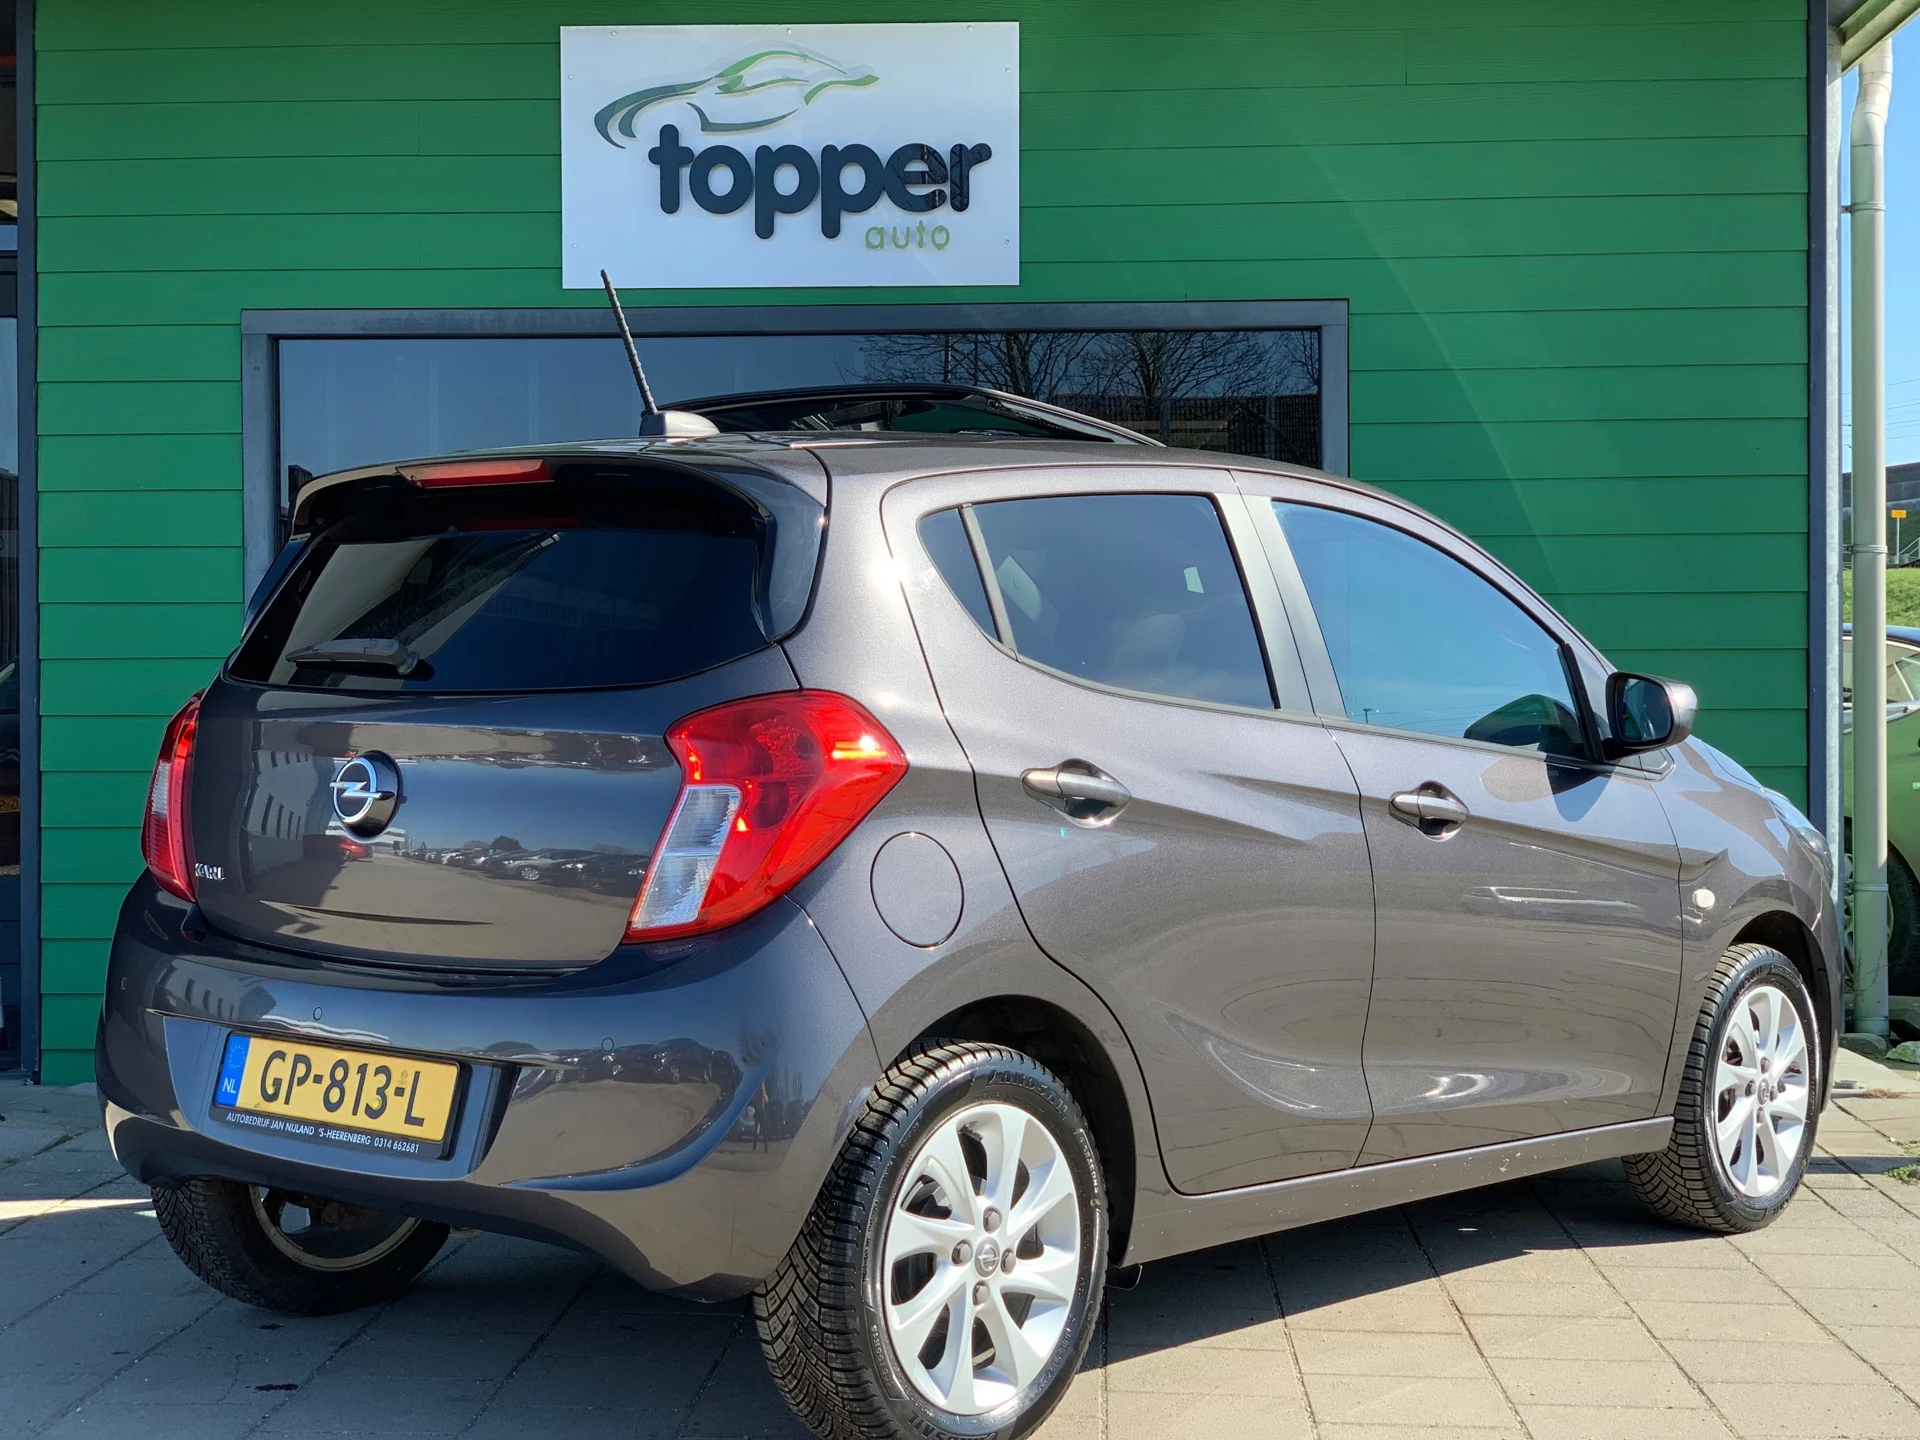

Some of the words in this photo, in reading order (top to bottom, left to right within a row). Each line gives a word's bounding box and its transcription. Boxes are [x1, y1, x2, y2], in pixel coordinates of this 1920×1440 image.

[648, 123, 992, 239] topper
[865, 220, 950, 249] auto
[195, 863, 226, 880] KARL
[222, 1077, 237, 1094] NL
[260, 1050, 425, 1127] GP-813-L
[226, 1112, 270, 1127] AUTOBEDRIJF
[270, 1119, 285, 1130] JAN
[285, 1123, 315, 1135] NIJLAND
[374, 1137, 391, 1149] 0314
[393, 1140, 419, 1154] 662681
